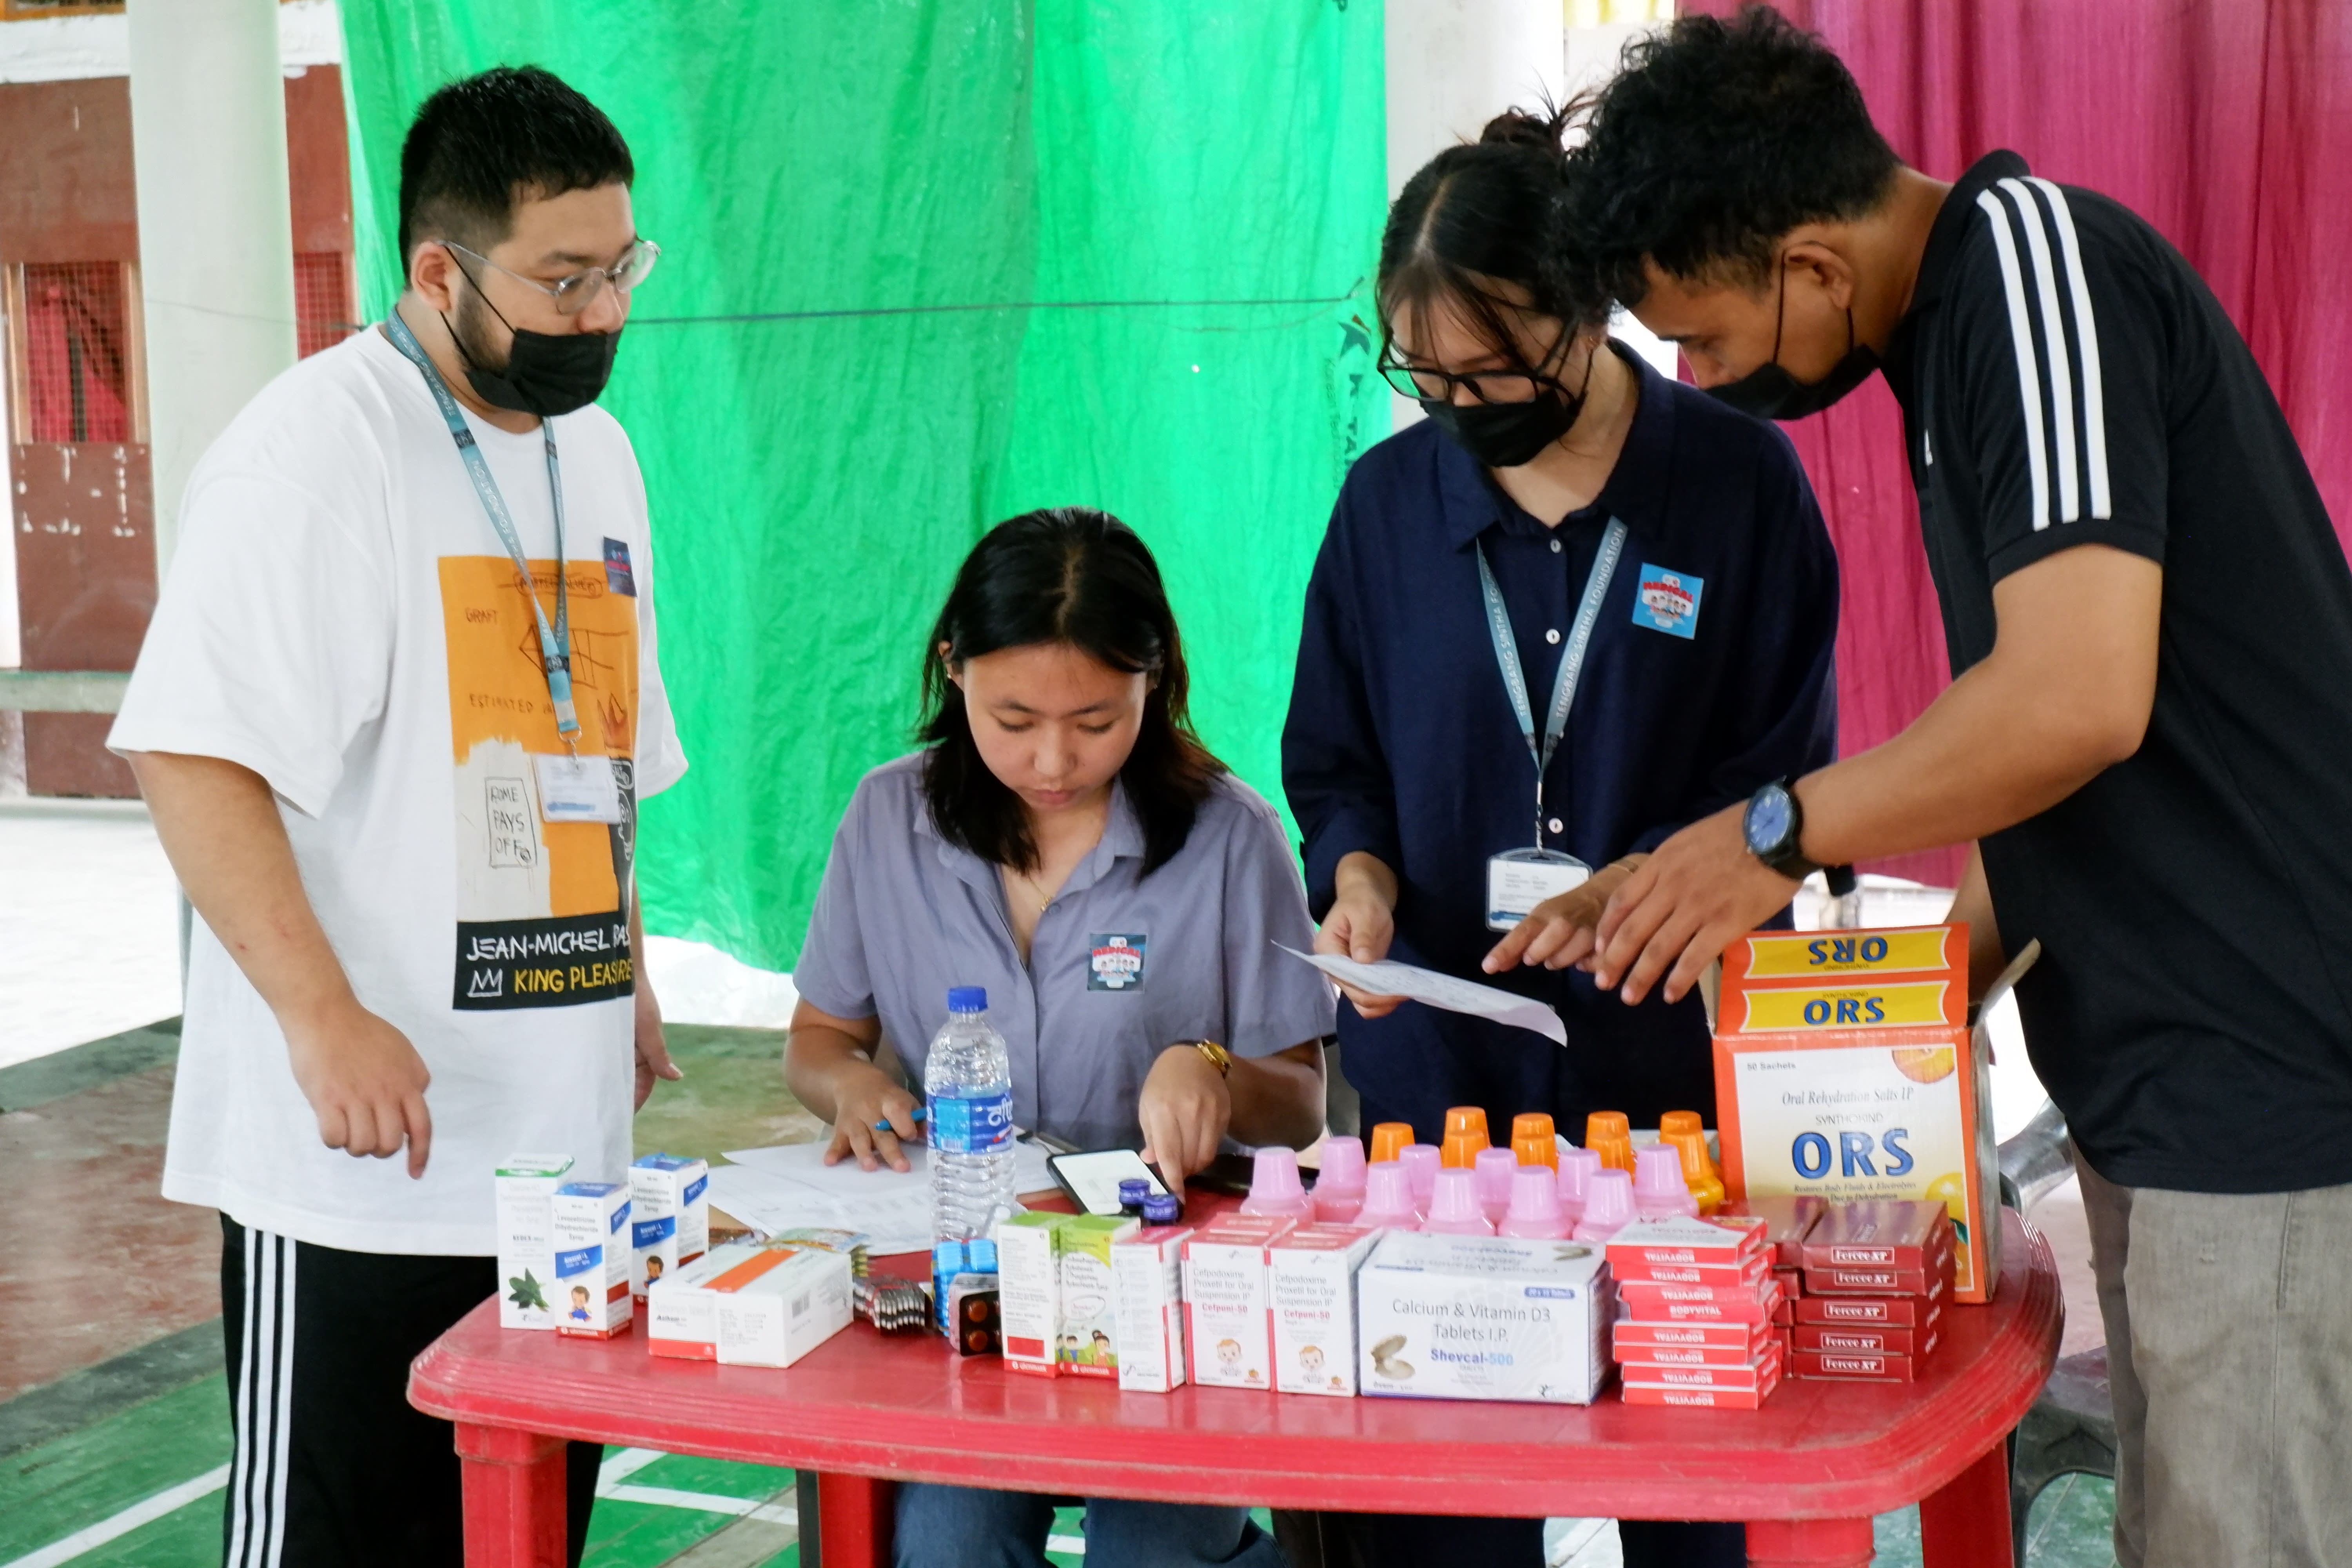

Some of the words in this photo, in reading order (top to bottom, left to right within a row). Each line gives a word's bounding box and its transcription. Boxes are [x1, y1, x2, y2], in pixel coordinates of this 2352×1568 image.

[1590, 526, 1625, 606] FOUNDATION
[491, 786, 519, 802] ROME
[493, 809, 524, 834] PAYS
[496, 837, 522, 856] OFF
[466, 927, 611, 960] JEAN-MICHEL
[1809, 936, 1888, 965] ORS
[514, 968, 565, 993] KING
[1804, 997, 1885, 1025] ORS
[1760, 1062, 1796, 1071] Sachets
[1782, 1091, 1805, 1105] Oral
[1808, 1090, 1870, 1107] Rehydration
[1874, 1088, 1898, 1102] Salts
[1902, 1086, 1914, 1102] IP
[1792, 1128, 1914, 1179] ORS
[1195, 1289, 1240, 1299] Suspension
[1238, 1281, 1254, 1290] Oral
[1320, 1287, 1336, 1295] Oral
[1276, 1295, 1322, 1307] Suspension
[1393, 1298, 1448, 1316] Calcium
[1454, 1302, 1465, 1317] &
[1470, 1303, 1526, 1321] Vitamin
[1532, 1307, 1550, 1323] D3
[1669, 1306, 1722, 1315] BODYVITAL
[1434, 1323, 1484, 1341] Tablets
[1489, 1328, 1509, 1343] I.P.
